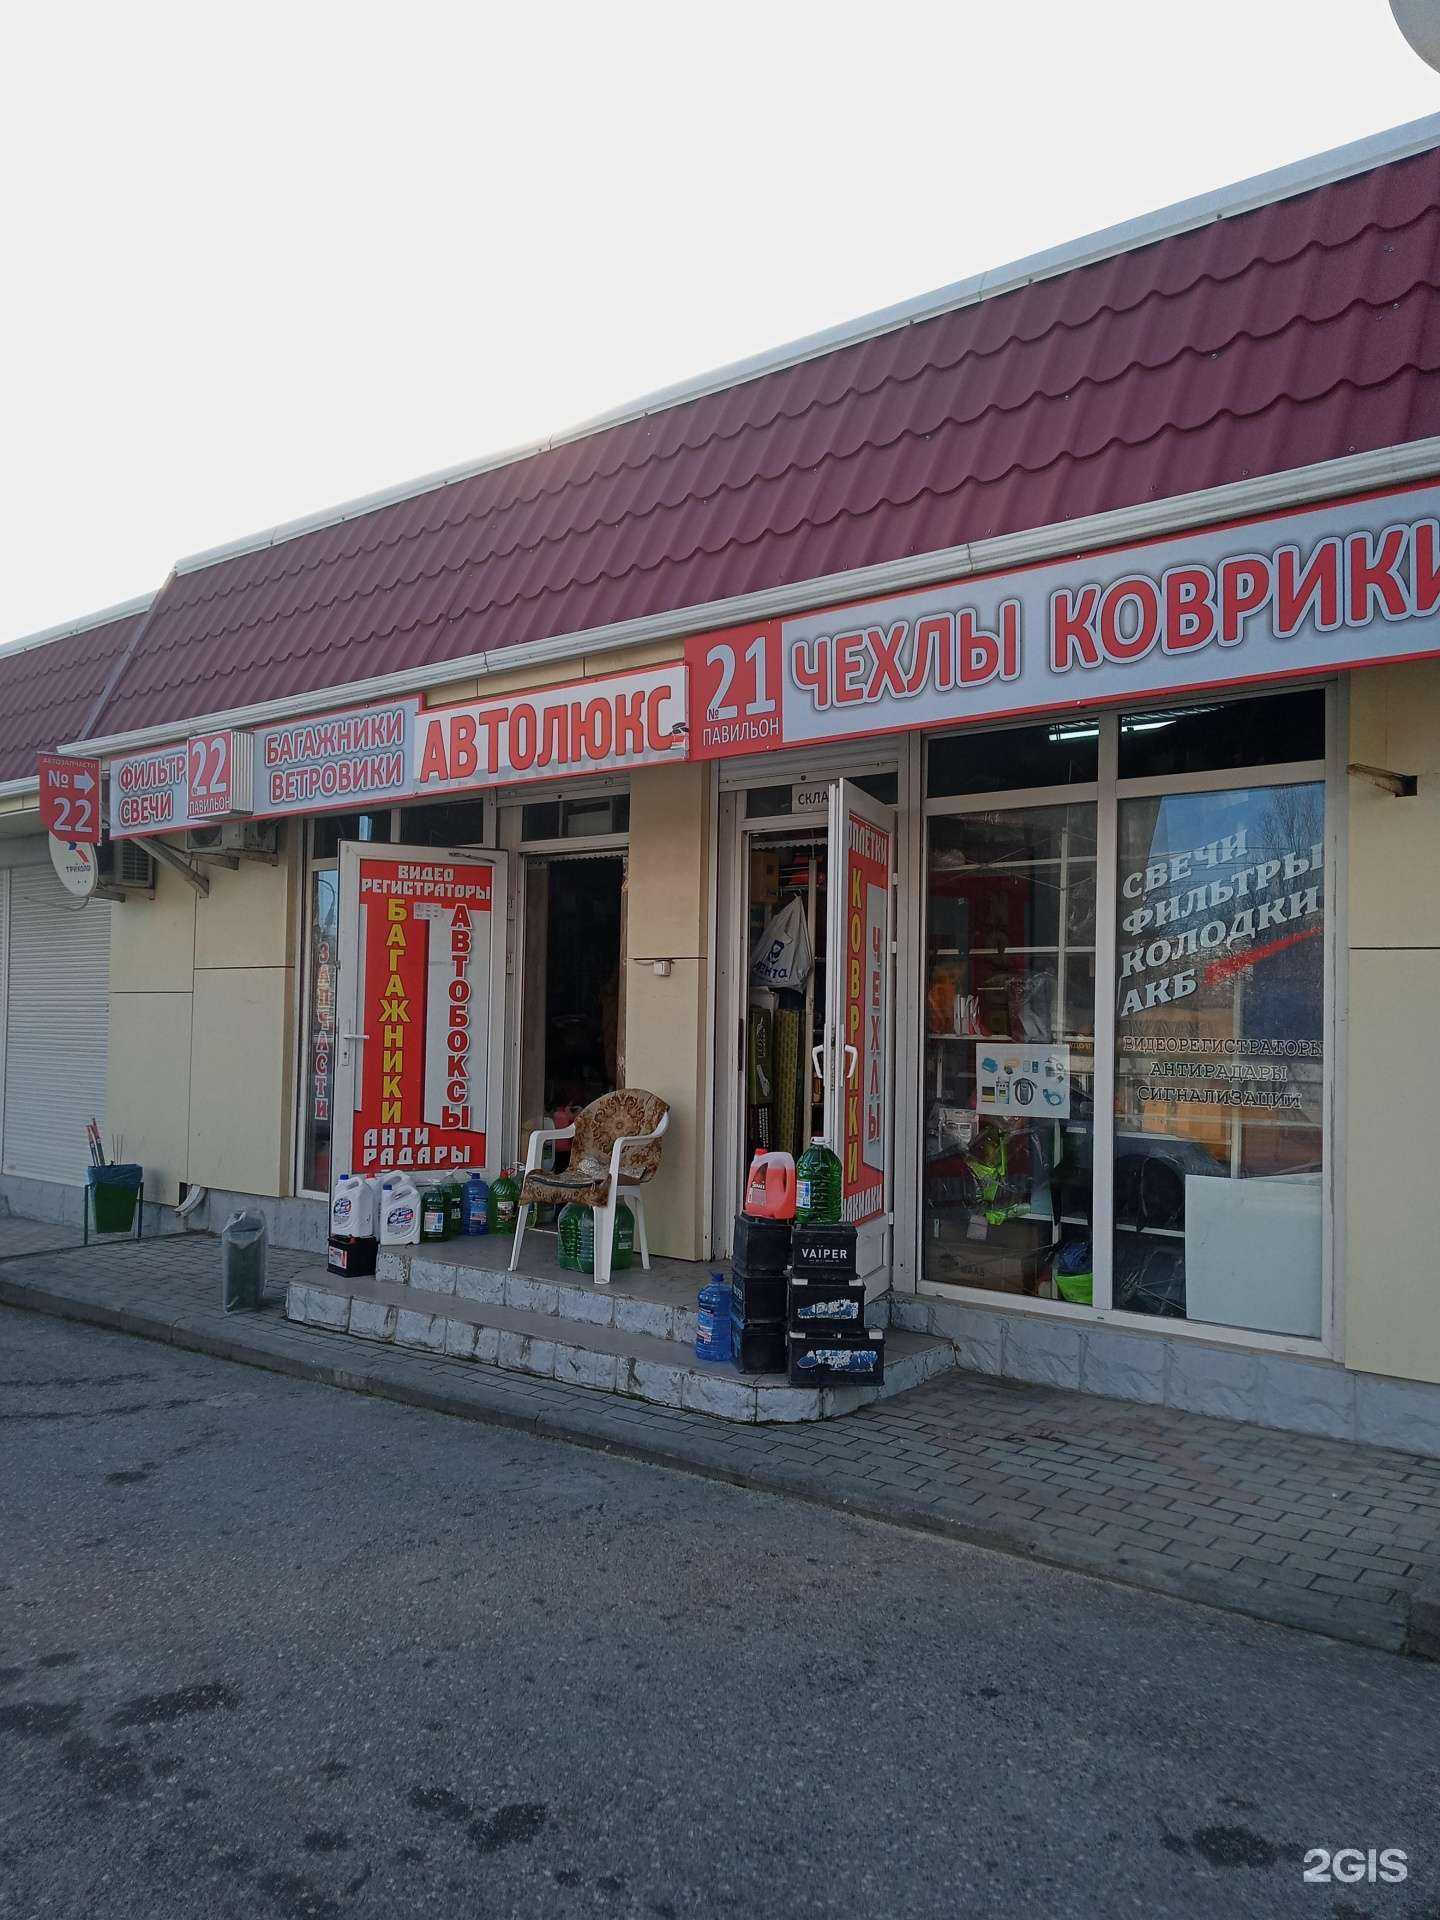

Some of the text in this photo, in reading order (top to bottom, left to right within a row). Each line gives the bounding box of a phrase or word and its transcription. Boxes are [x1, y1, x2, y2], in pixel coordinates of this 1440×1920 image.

[706, 636, 776, 721] 21
[793, 601, 1022, 711] ЧЕХЛЫ
[265, 709, 403, 767] БАГАЖНИКИ
[419, 684, 683, 784] АВТОЛЮКС
[703, 717, 779, 746] ПАВИЛЬОН
[48, 770, 69, 788] №
[118, 752, 188, 793] ФИЛЬТР
[191, 738, 227, 797] 22
[270, 751, 403, 804] ВЕТРОВИКИ
[53, 797, 93, 833] 22
[120, 790, 173, 826] СВЕЧИ
[189, 796, 230, 815] ПАВИЛЬОН
[798, 791, 829, 805] СКЛА
[398, 865, 454, 882] ВИДЕО
[1122, 829, 1248, 900] СВЕЧИ
[361, 879, 491, 900] РЕГИСТРАТОРЫ
[1122, 843, 1324, 937] ФИЛЬТРЫ
[1121, 886, 1319, 979] КОЛОДКИ
[377, 898, 411, 1125] БАГАЖНИКИ
[1120, 968, 1199, 1017] АКБ
[439, 903, 473, 1130] АВТОБОКСЫ
[867, 925, 882, 1142] ЧЕХЛЫ
[1150, 1061, 1288, 1082] АНТИРАДАРЫ
[1137, 1086, 1302, 1109] СИГНАЛИЗАЦИИ
[362, 1127, 429, 1147] АНТИ
[362, 1145, 472, 1168] РАДАРЫ
